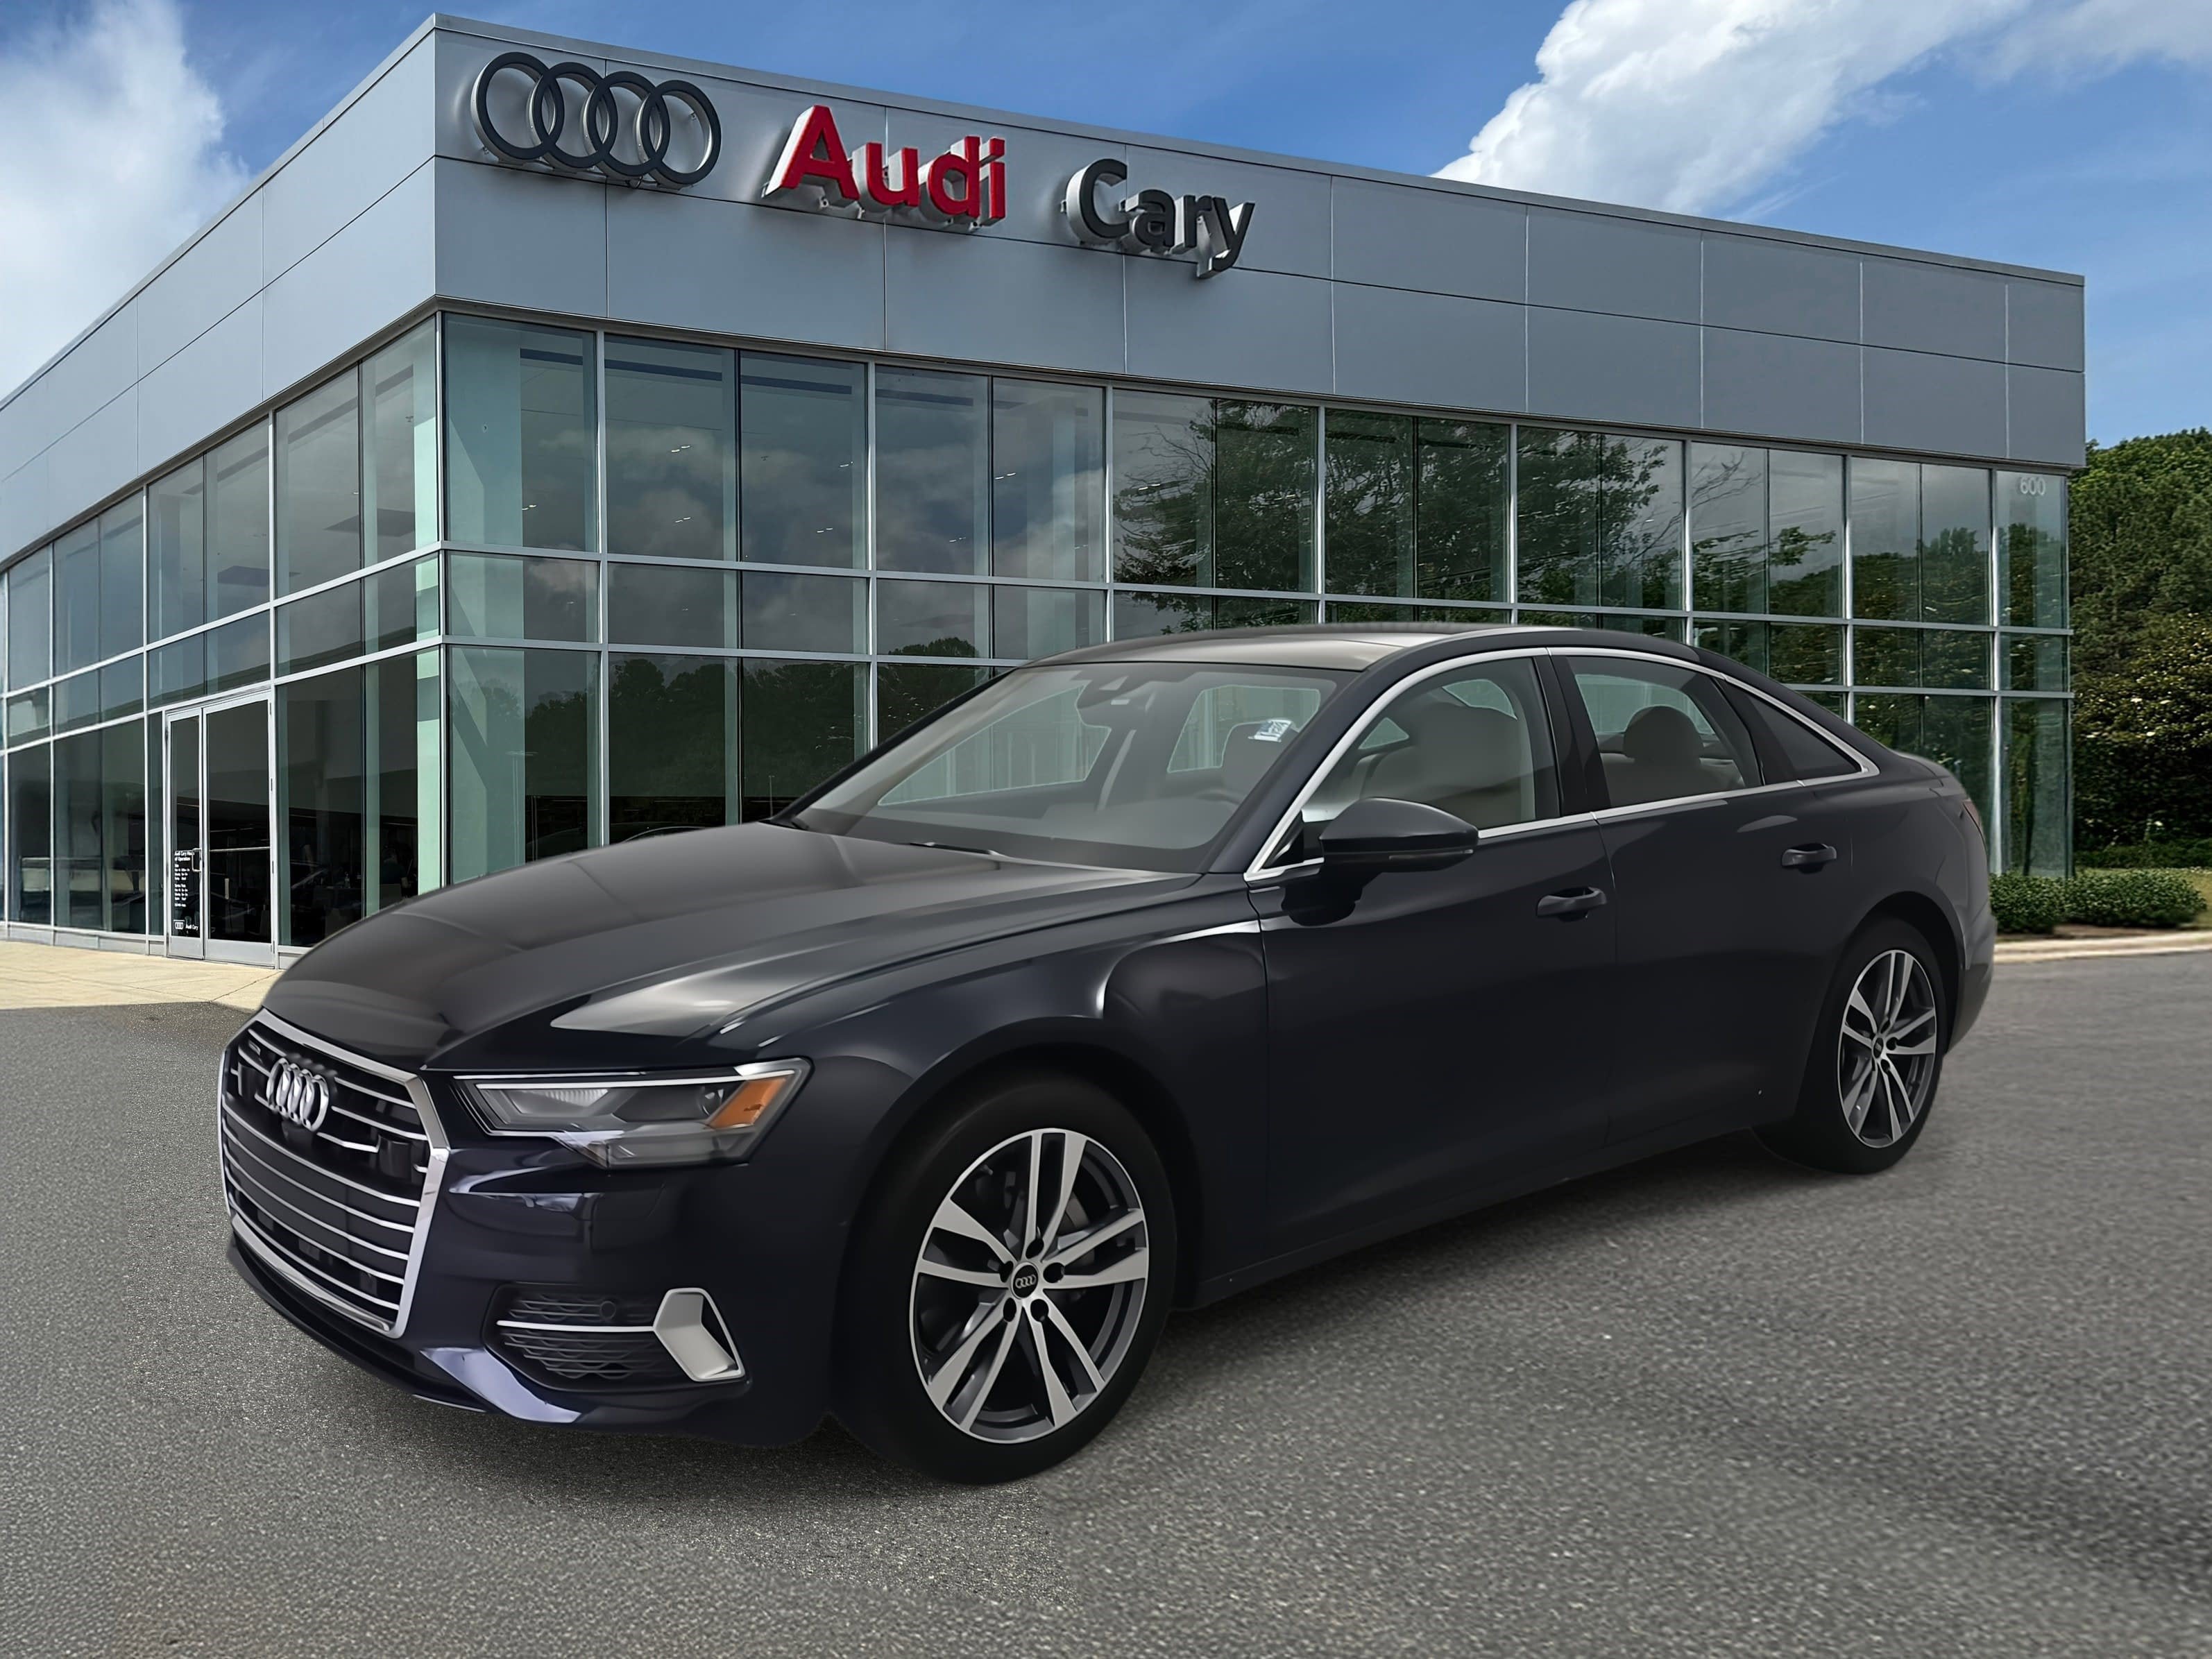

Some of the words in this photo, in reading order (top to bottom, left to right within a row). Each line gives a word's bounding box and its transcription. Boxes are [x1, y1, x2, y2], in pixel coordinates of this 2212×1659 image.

[765, 105, 1005, 222] Audi
[1067, 158, 1255, 276] Cary
[2020, 476, 2045, 495] 600
